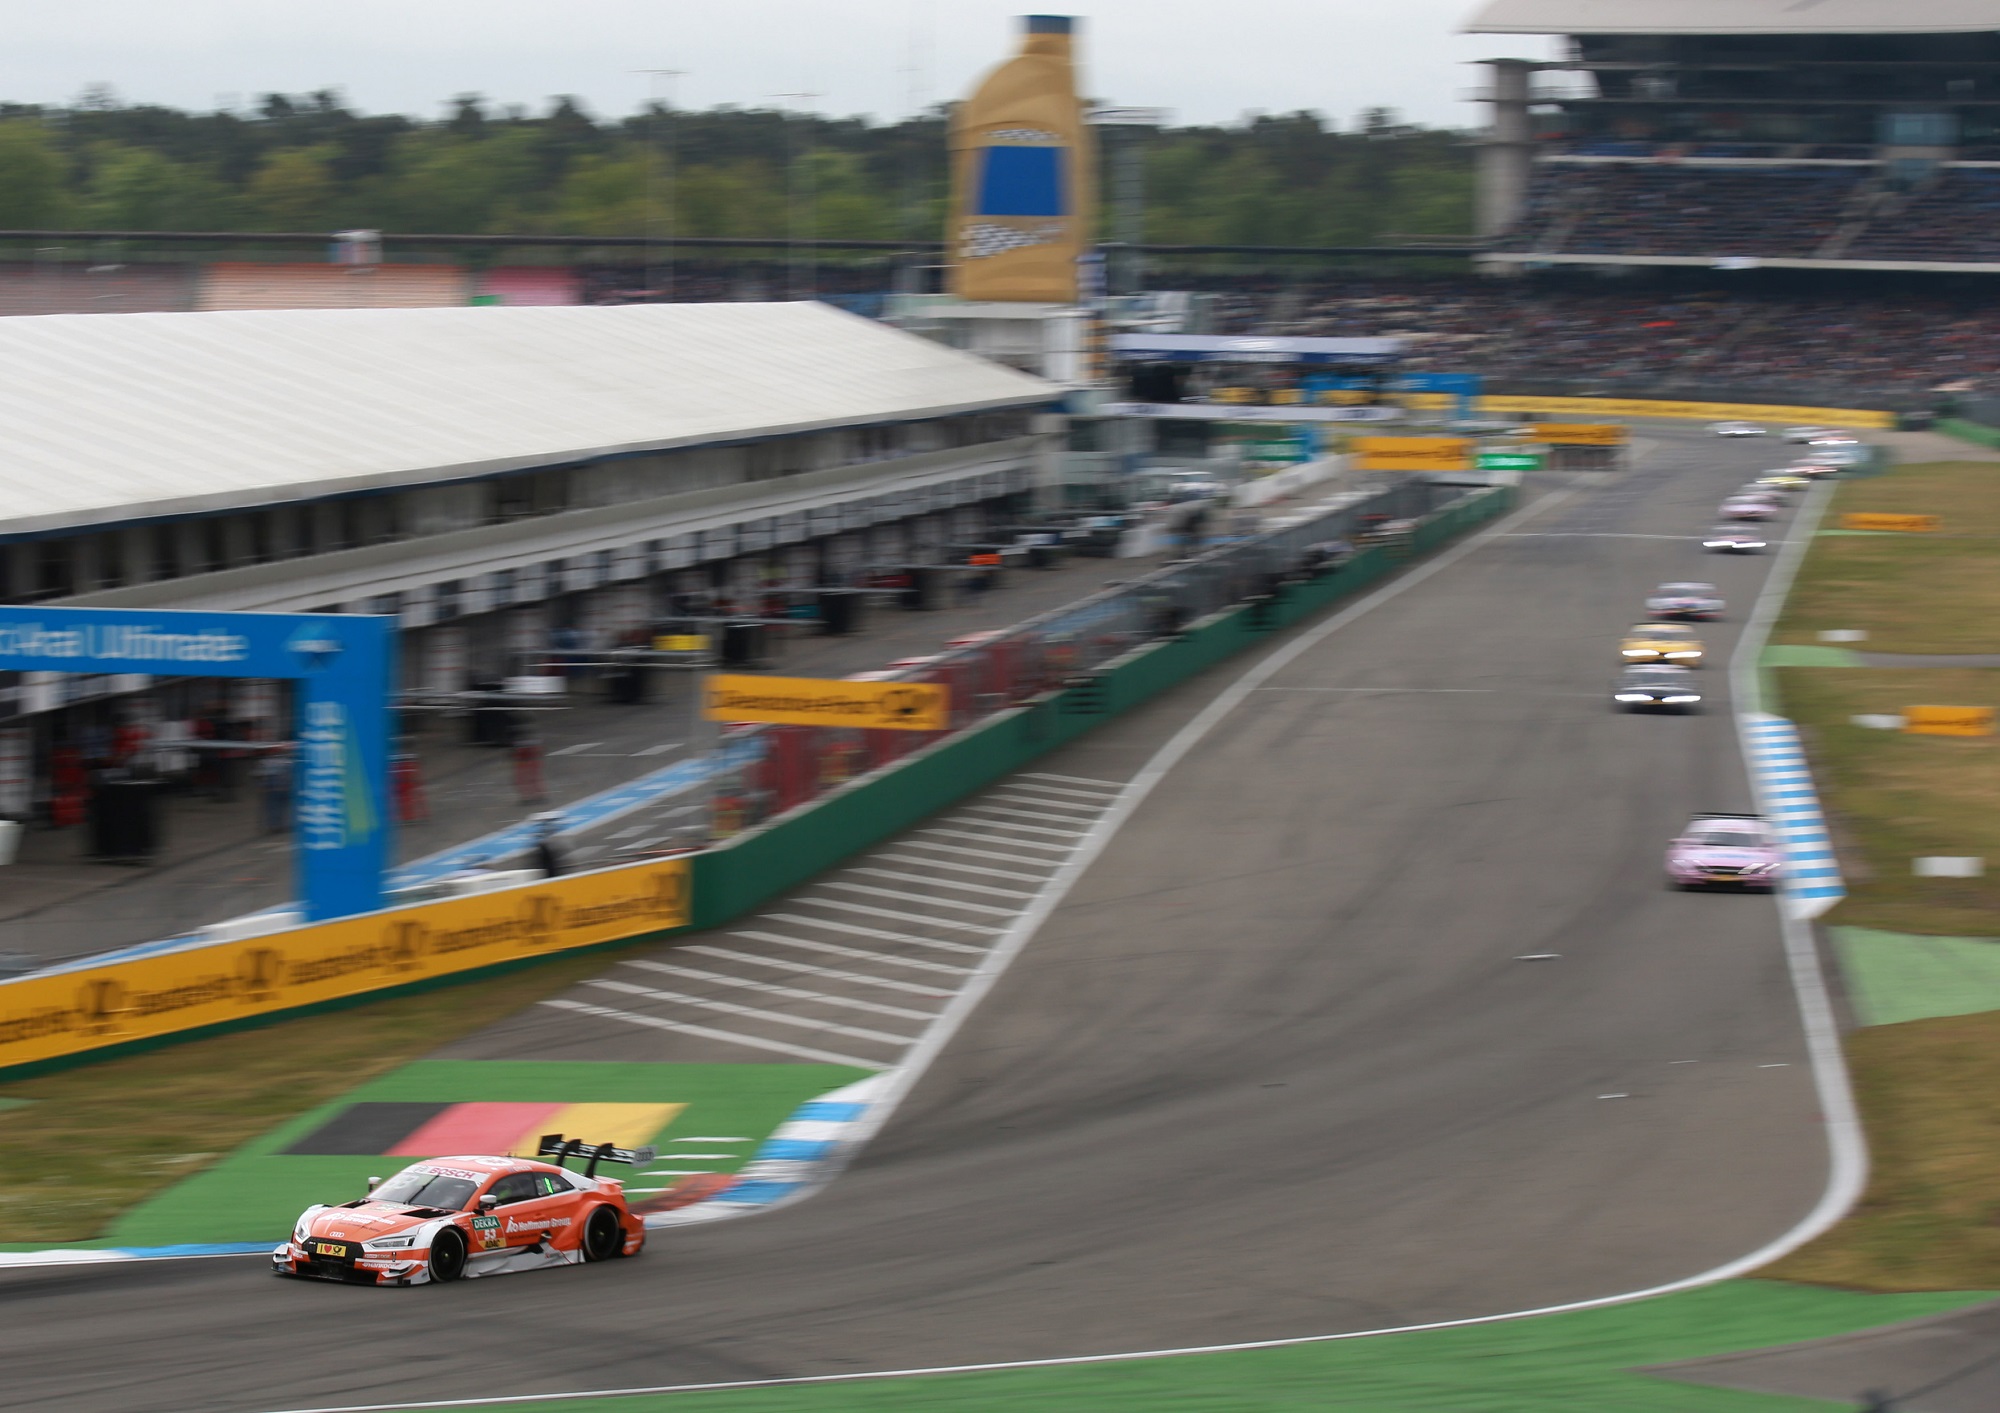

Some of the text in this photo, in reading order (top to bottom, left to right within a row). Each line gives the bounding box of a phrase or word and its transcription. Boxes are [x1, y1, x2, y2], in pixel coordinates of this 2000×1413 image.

[86, 623, 250, 662] Ultimate
[428, 1167, 475, 1179] BOSCH
[474, 1217, 498, 1229] DEKRA
[484, 1228, 497, 1240] 53
